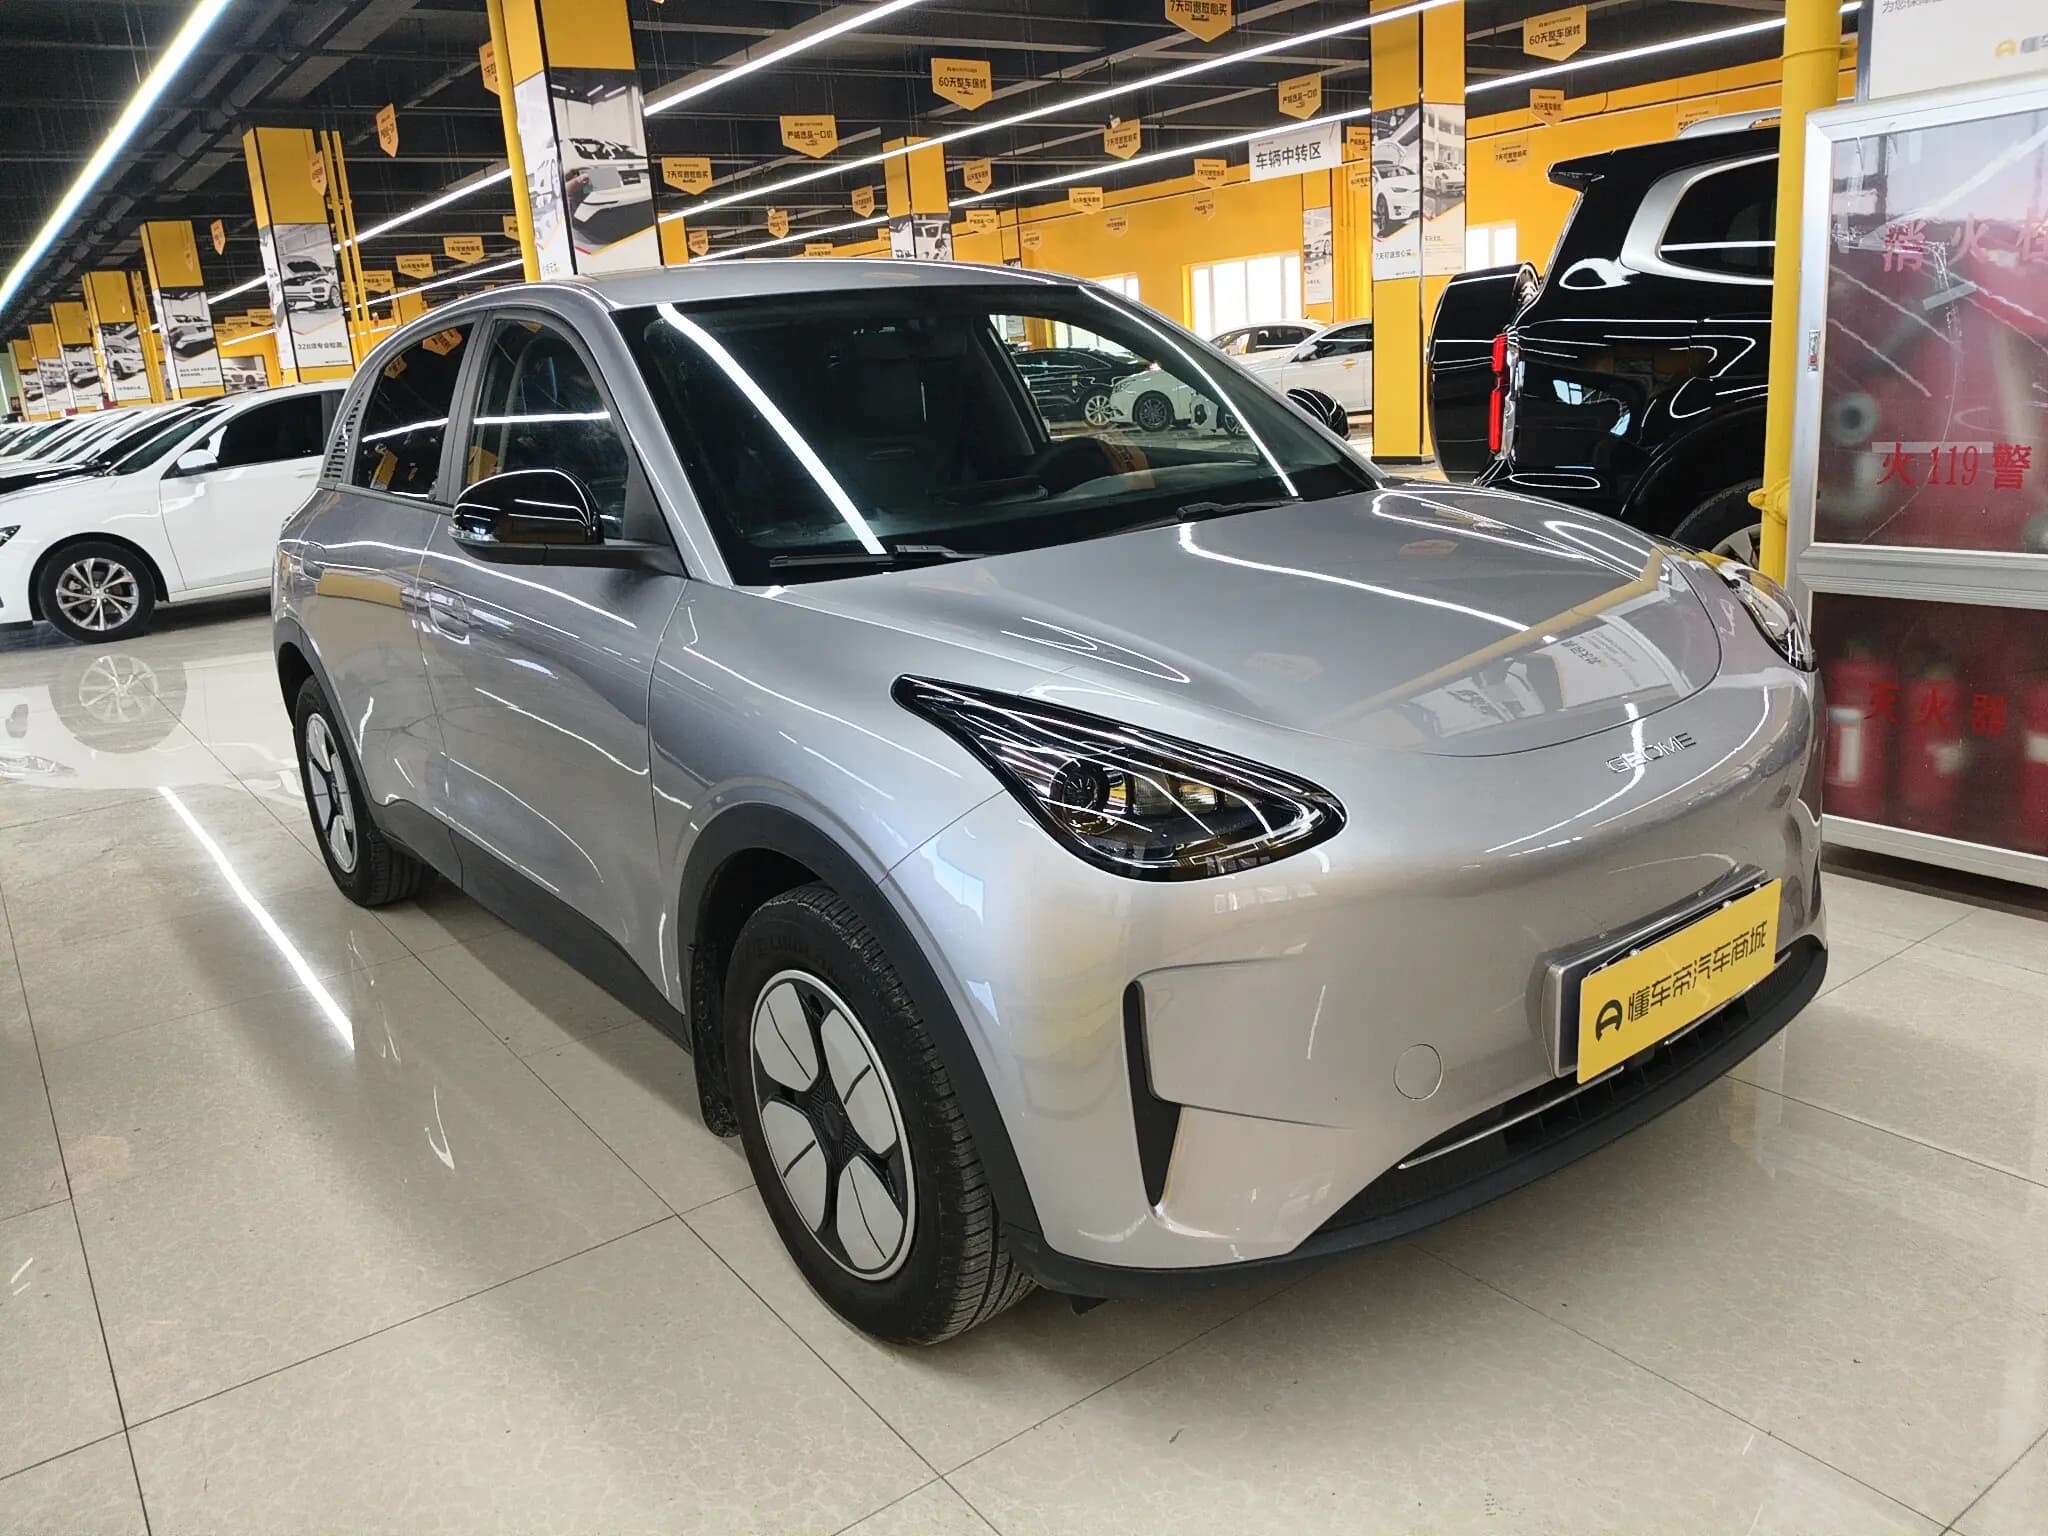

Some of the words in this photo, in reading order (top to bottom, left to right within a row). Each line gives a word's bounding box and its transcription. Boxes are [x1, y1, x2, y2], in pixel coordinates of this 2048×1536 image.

[1529, 24, 1580, 46] 60天整车保修
[938, 76, 987, 89] 60天整车保修
[1255, 141, 1322, 170] 车辆中转区
[1606, 732, 1697, 773] GEOME
[1628, 919, 1768, 1023] 懂车帝汽车商城
